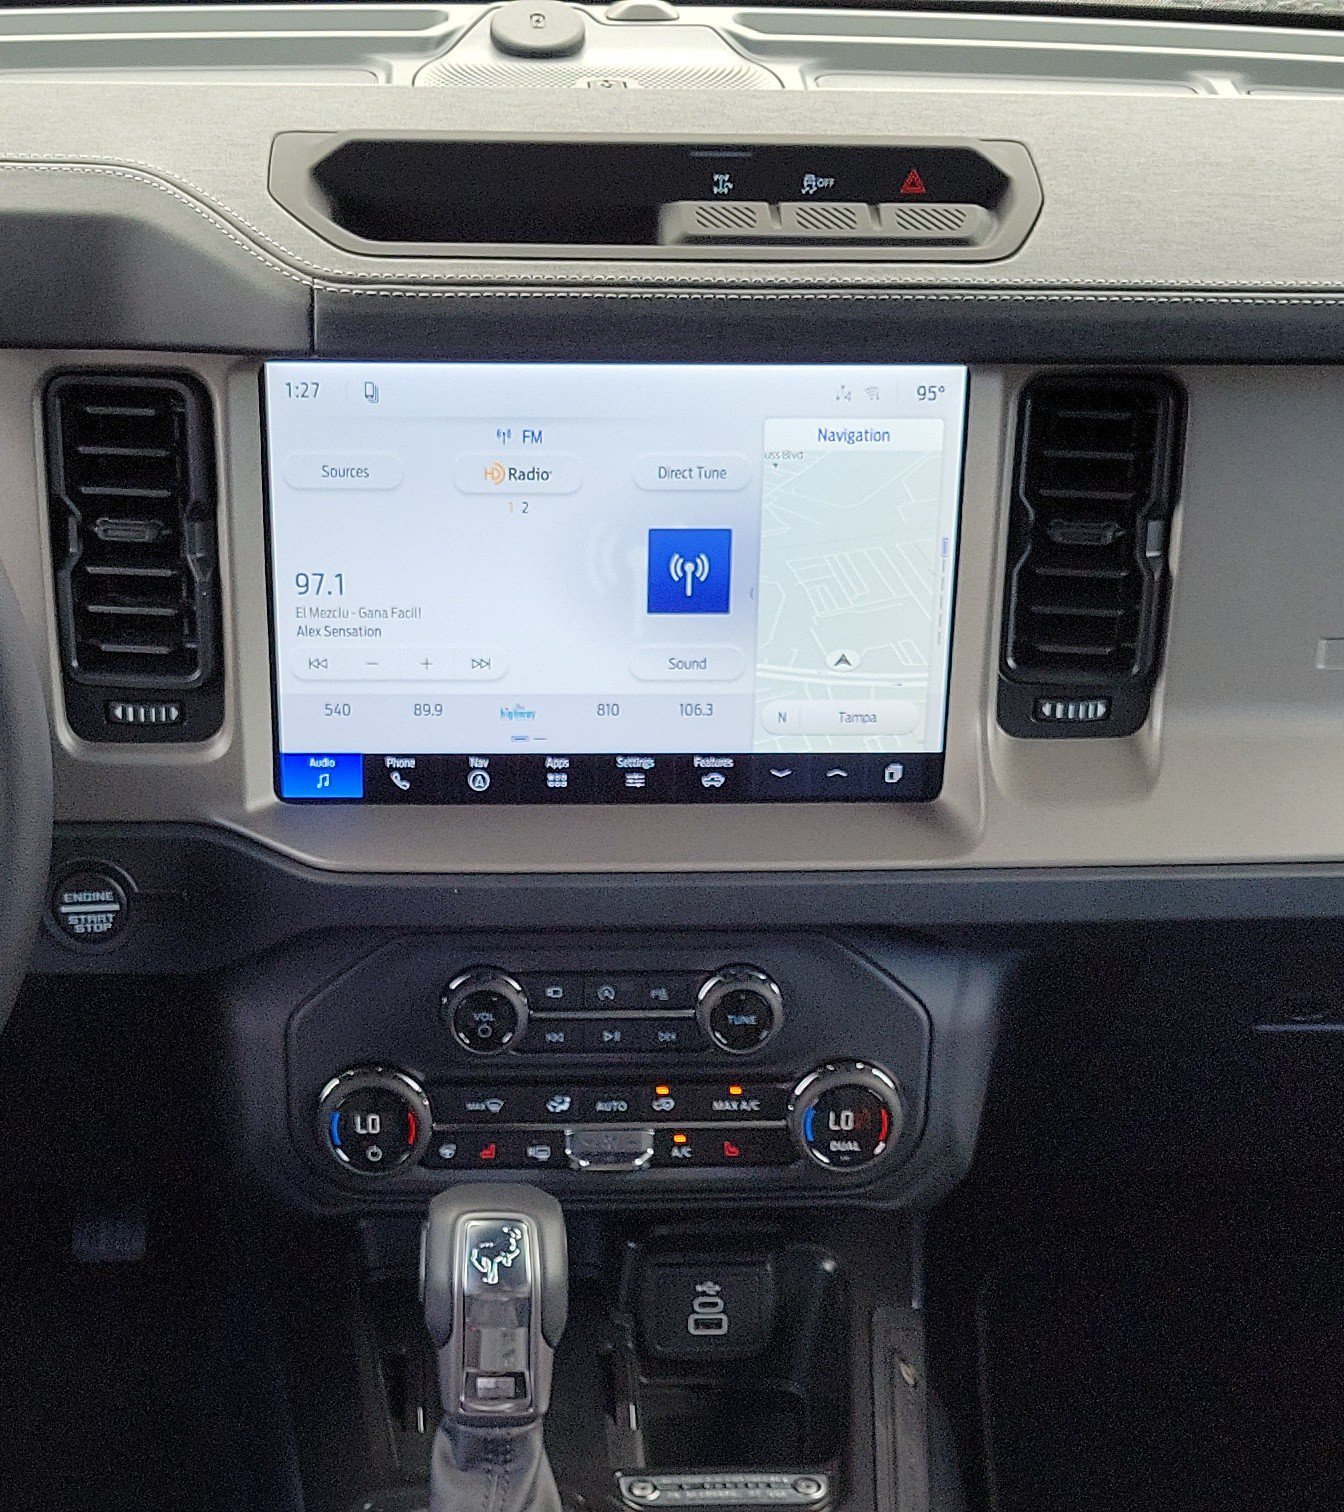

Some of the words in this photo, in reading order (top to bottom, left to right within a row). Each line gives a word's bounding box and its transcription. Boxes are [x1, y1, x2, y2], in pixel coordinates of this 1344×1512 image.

[285, 382, 320, 399] 1:27
[916, 385, 946, 401] 95°
[522, 430, 543, 444] FM
[817, 428, 891, 445] Navigation
[321, 464, 370, 479] Sources
[508, 467, 550, 482] Radio
[657, 466, 694, 480] Direct
[697, 466, 727, 480] Tune
[521, 502, 529, 514] 2
[295, 572, 345, 596] 97.1
[296, 606, 307, 619] El
[358, 606, 389, 619] Gana
[296, 625, 322, 638] Alex
[323, 625, 383, 639] Sensation
[668, 657, 708, 672] Sound
[324, 703, 352, 718] 540
[413, 703, 444, 717] 89.9
[596, 703, 620, 717] 810
[678, 703, 714, 717] 106.3
[777, 711, 788, 724] N
[838, 711, 877, 726] Tampa
[309, 757, 336, 769] Audio
[386, 756, 416, 769] Phone
[469, 757, 490, 769] Nav
[545, 756, 570, 771] Apps
[615, 756, 655, 770] Settings
[693, 756, 735, 769] Features
[595, 1100, 628, 1112] AUTO
[712, 1100, 739, 1111] MAX
[355, 1114, 381, 1134] LO
[828, 1110, 855, 1131] LO
[829, 1140, 862, 1152] DUAL
